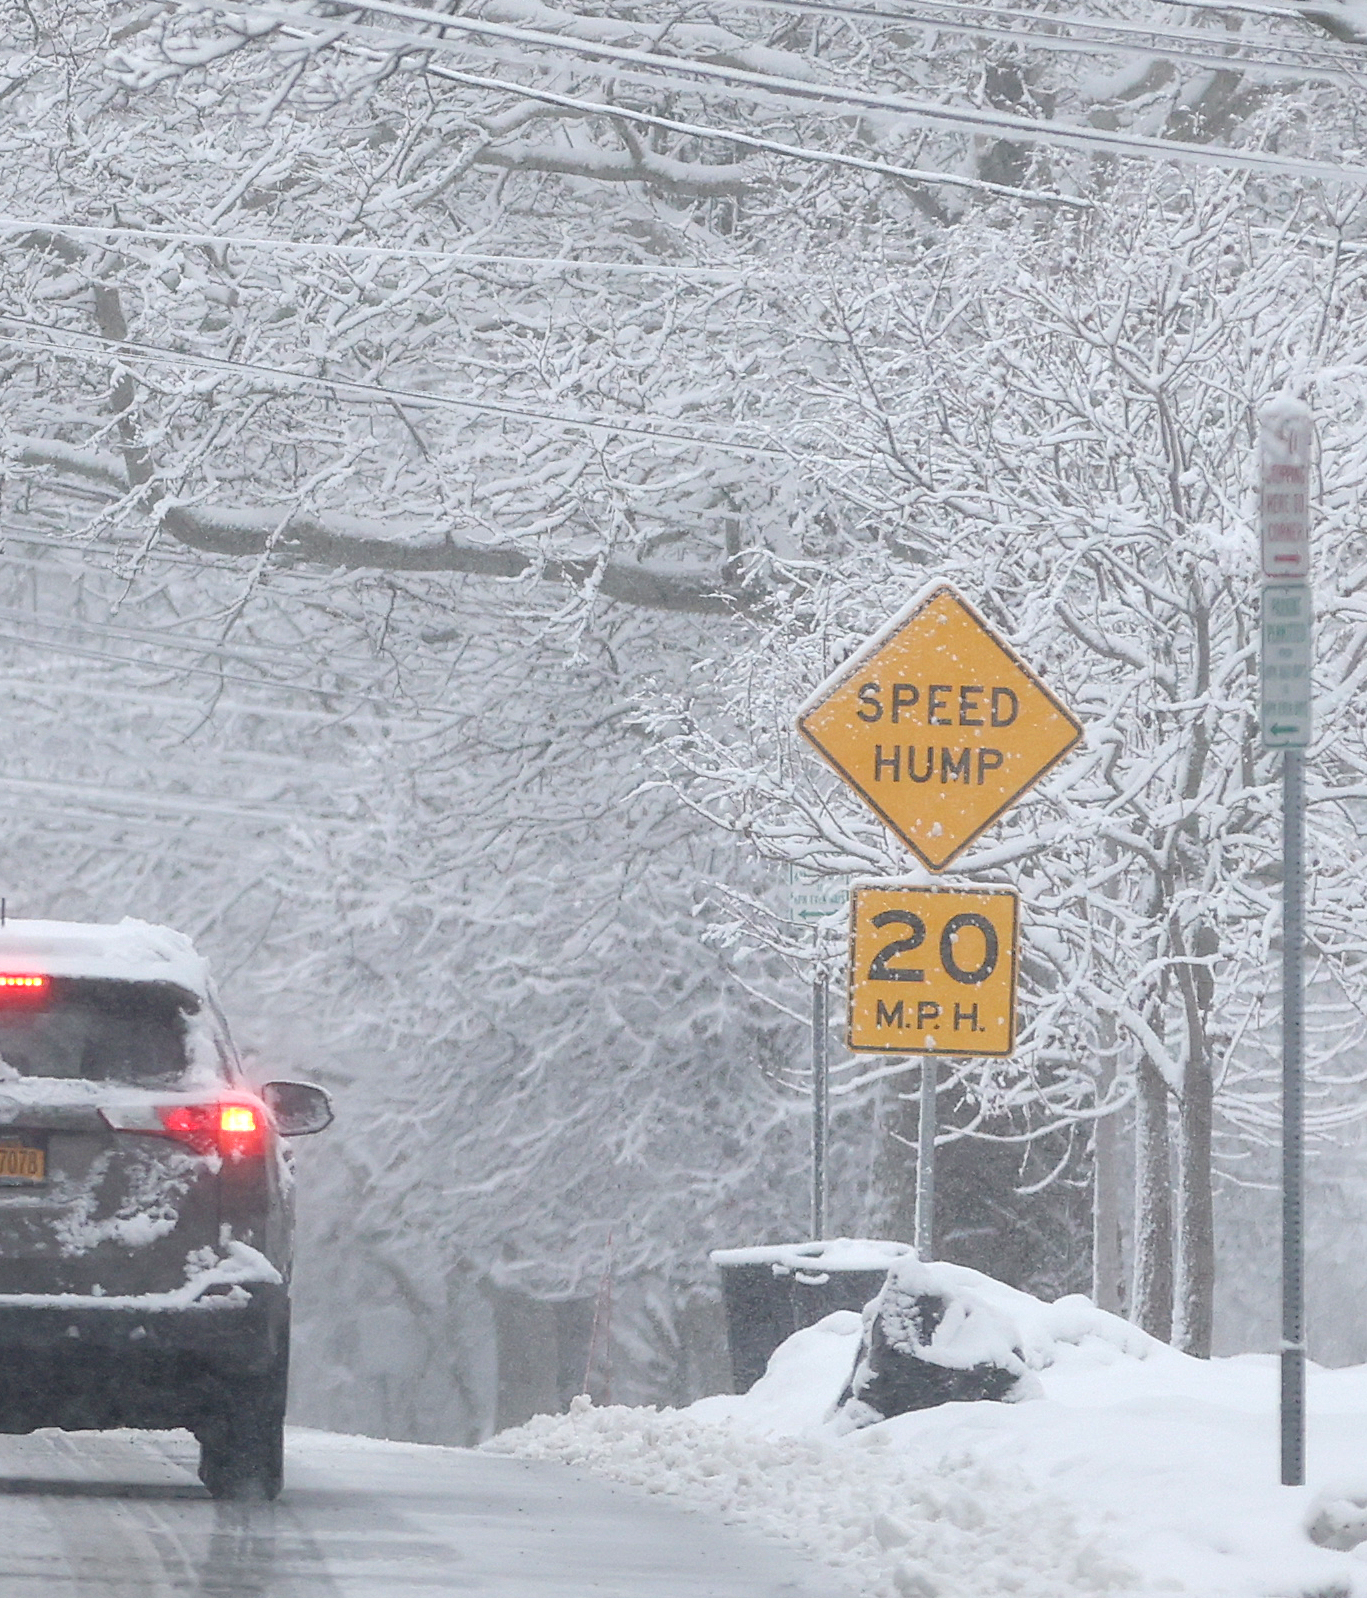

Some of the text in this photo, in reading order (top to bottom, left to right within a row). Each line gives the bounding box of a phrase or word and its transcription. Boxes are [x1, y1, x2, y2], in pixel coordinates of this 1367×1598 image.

[856, 682, 1020, 728] SPEED
[874, 744, 1005, 785] HUMP
[867, 909, 999, 985] 20
